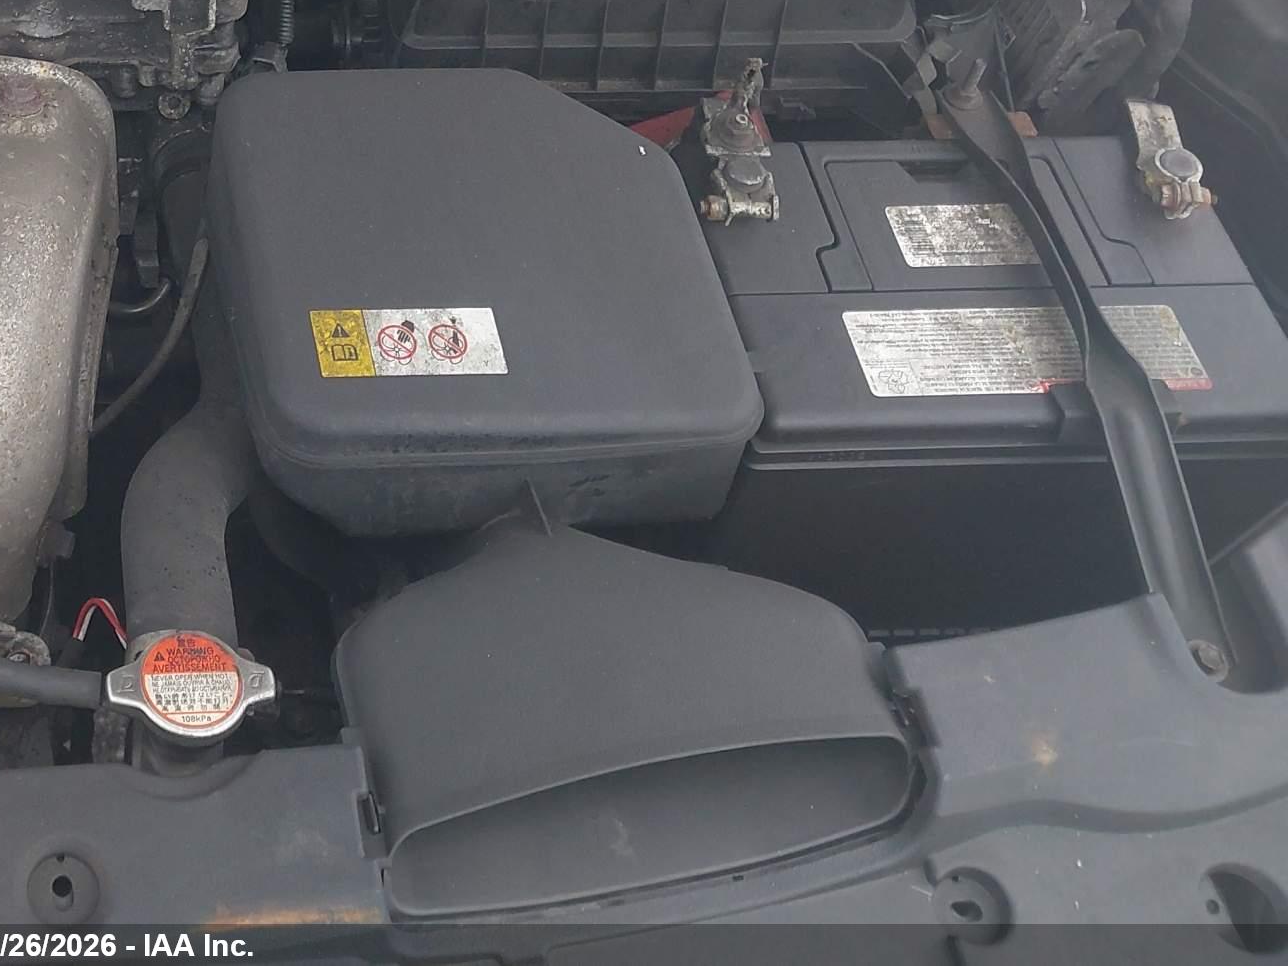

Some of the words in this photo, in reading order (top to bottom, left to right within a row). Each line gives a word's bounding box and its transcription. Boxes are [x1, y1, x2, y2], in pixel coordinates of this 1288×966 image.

[166, 647, 214, 655] WARNING
[153, 663, 227, 673] AVERTISSEMENT
[182, 715, 212, 723] 108kPa
